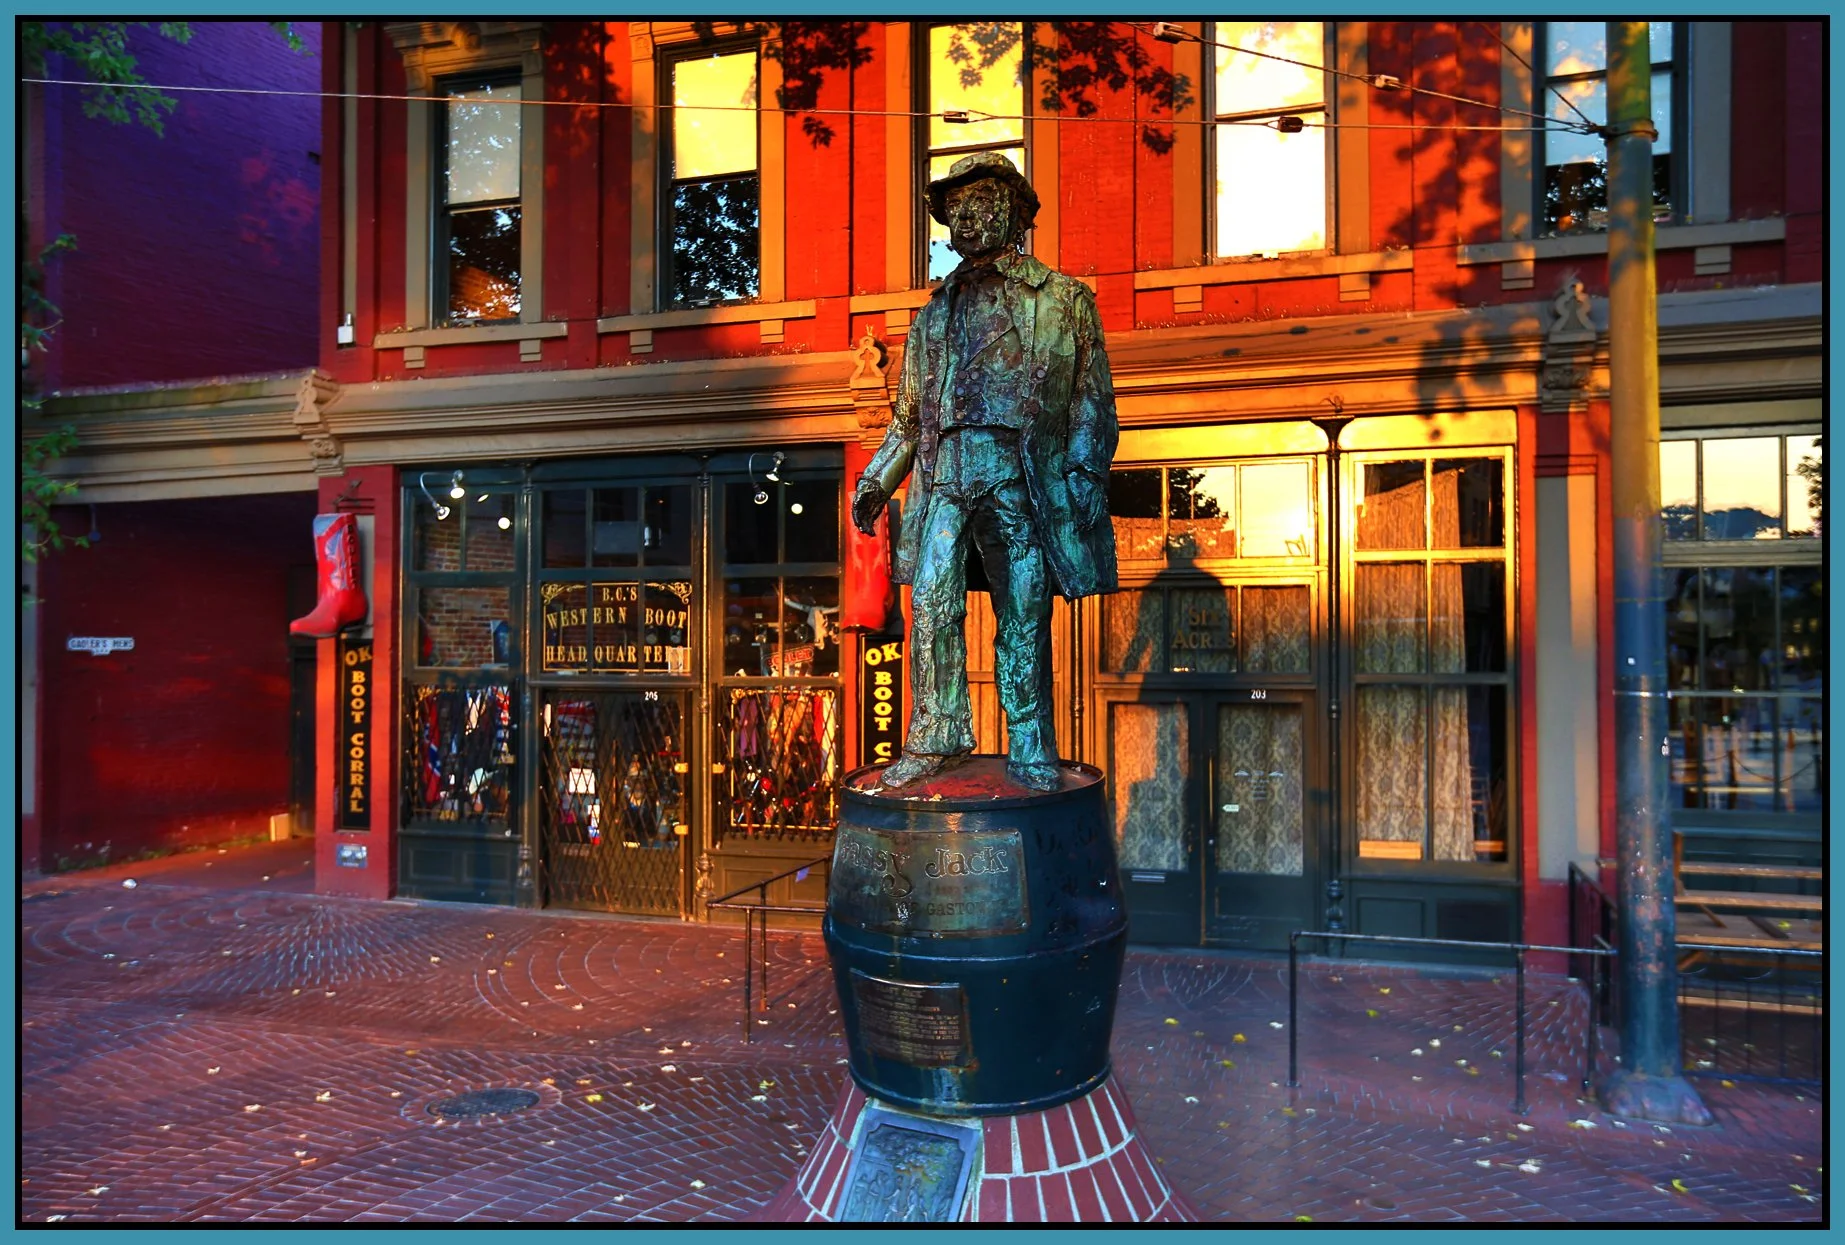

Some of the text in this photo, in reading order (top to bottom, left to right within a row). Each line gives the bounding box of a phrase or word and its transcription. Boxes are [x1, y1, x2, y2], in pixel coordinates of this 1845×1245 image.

[603, 586, 637, 601] B.C.'S
[547, 607, 686, 629] WESTERN BOOT
[1171, 629, 1236, 649] ACRS
[865, 643, 902, 666] OK
[645, 691, 658, 700] 205
[873, 671, 893, 731] BOOT
[1251, 689, 1266, 699] 203
[345, 646, 372, 812] OK BOOT CORRAL
[925, 846, 1009, 879] Jack
